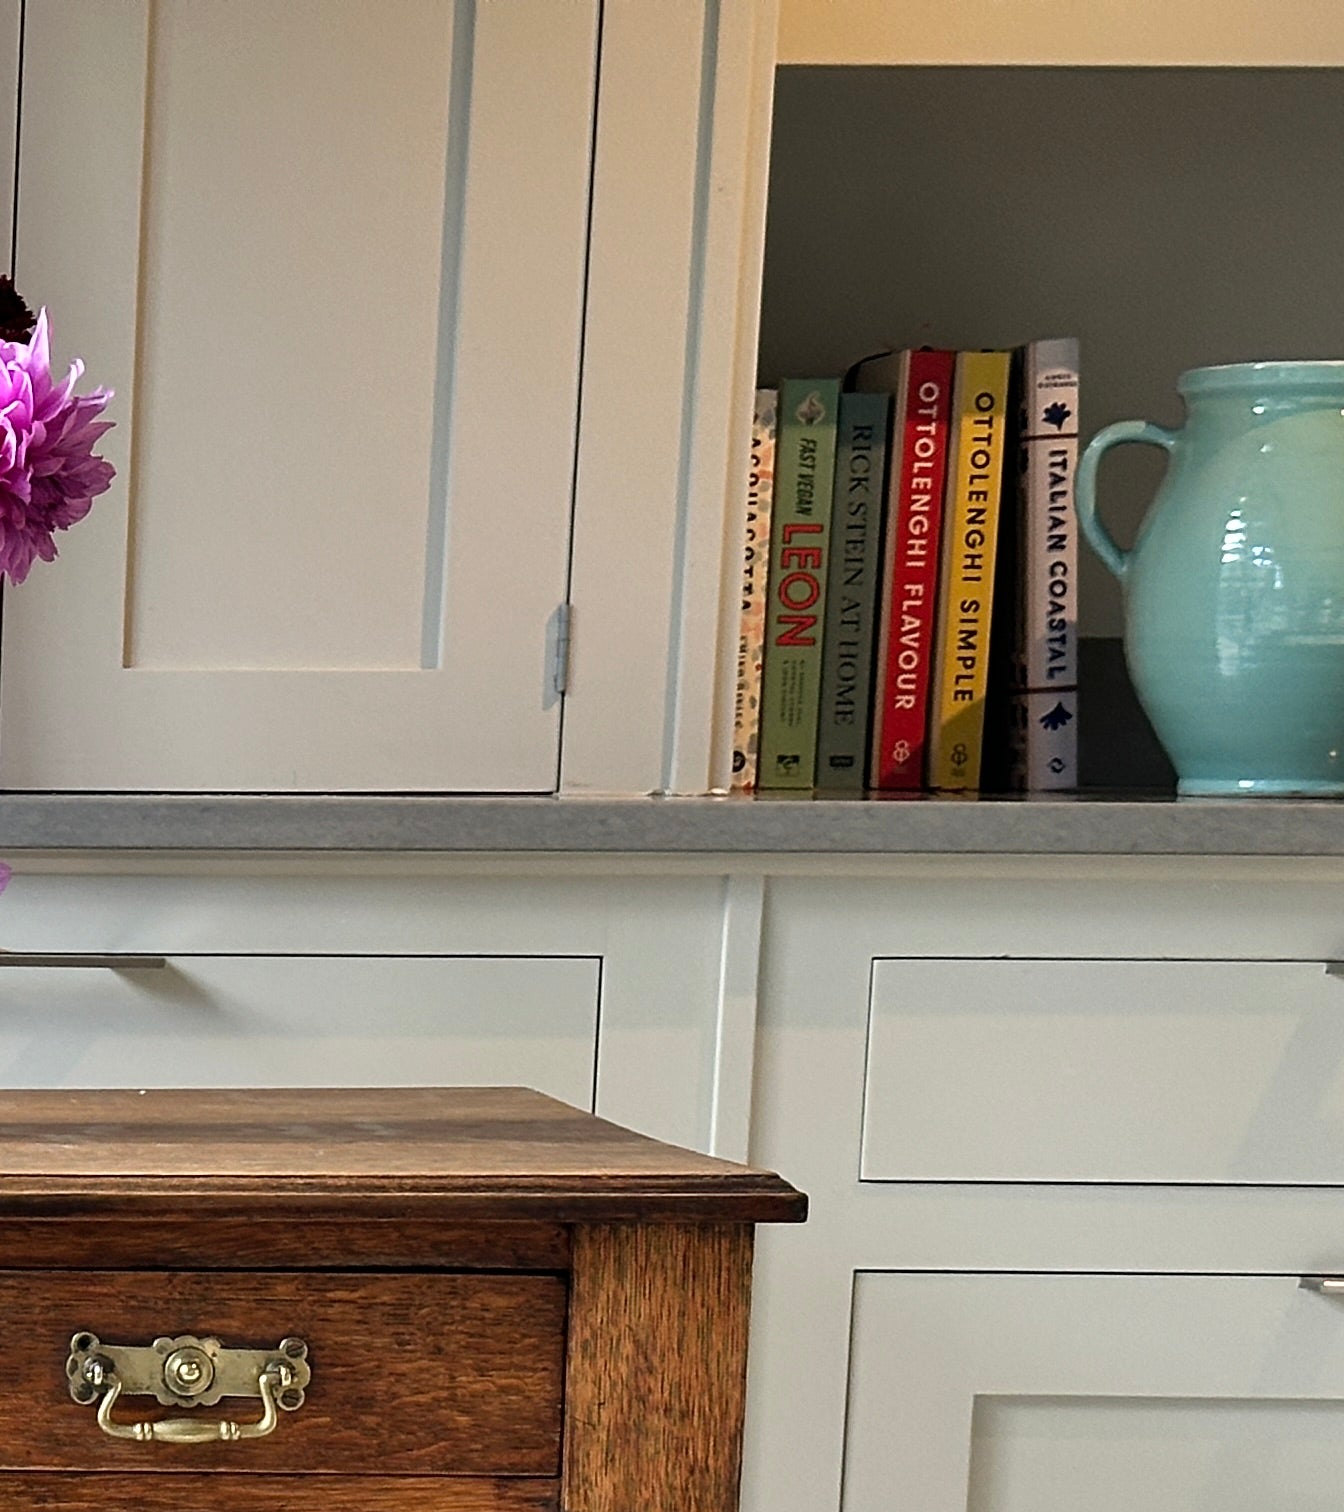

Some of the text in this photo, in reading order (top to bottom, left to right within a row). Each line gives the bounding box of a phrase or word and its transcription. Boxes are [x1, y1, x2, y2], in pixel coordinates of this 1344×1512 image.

[775, 523, 824, 647] LEON
[794, 438, 818, 516] FAST VEGAN
[834, 425, 873, 725] RICK STEIN AT HOME
[895, 381, 940, 710] OTTOLENGHI FLAVOUR
[952, 391, 995, 702] OTTOLENGHI SIMPLE
[1046, 448, 1069, 681] ITALIAN COASTAL
